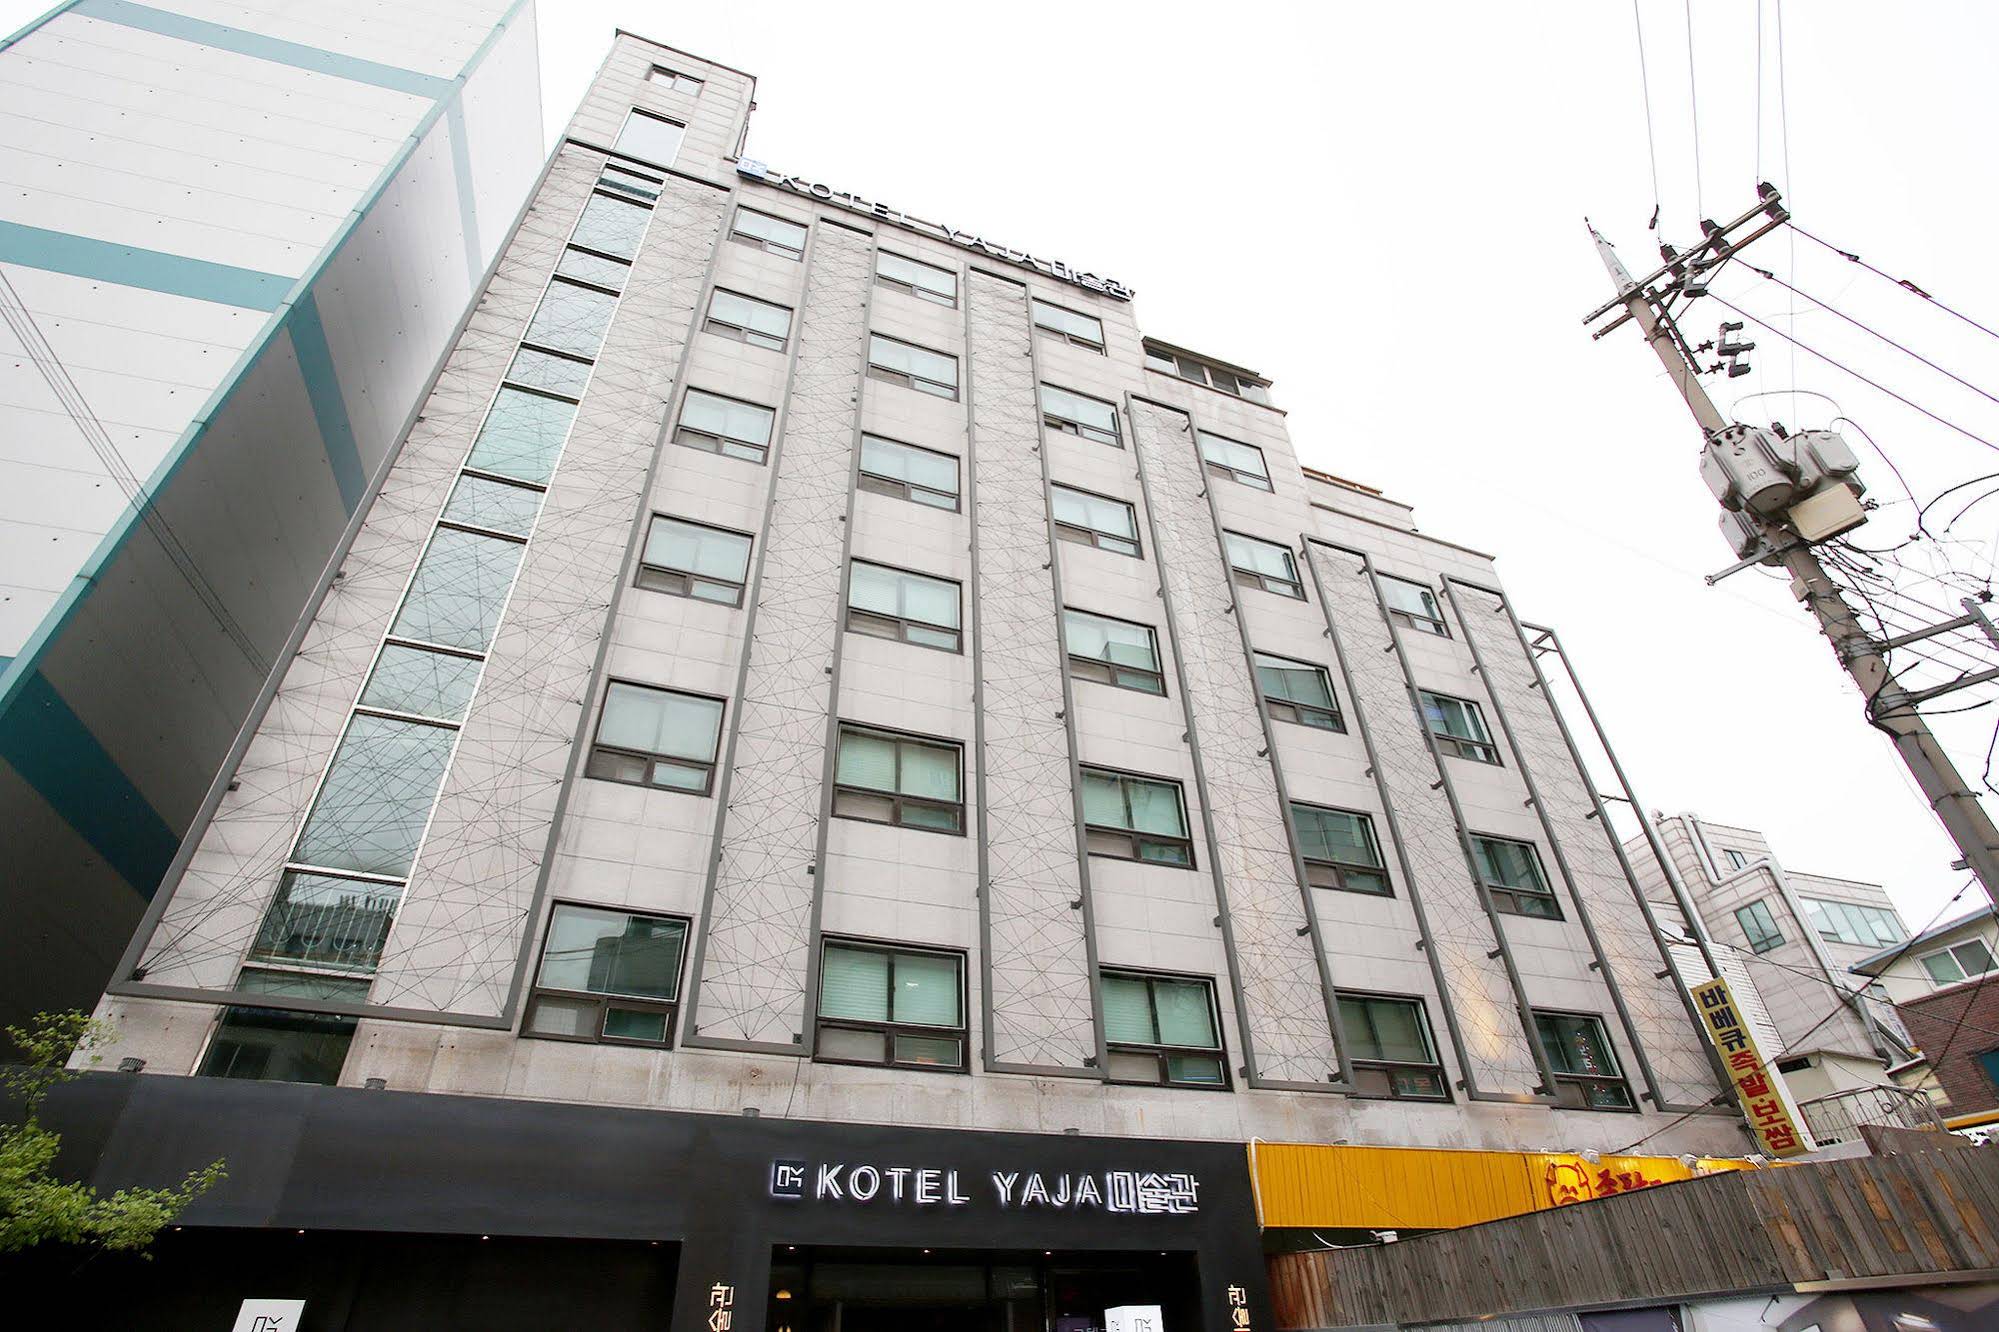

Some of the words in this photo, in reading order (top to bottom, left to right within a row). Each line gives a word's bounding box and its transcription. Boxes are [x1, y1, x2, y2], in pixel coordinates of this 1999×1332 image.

[778, 172, 916, 229] KOTEL
[940, 223, 1040, 271] YAJA
[1698, 984, 1747, 1052] 바베큐
[817, 1163, 971, 1204] KOTEL
[993, 1170, 1103, 1206] YAJA
[1106, 1171, 1200, 1213] 미술관
